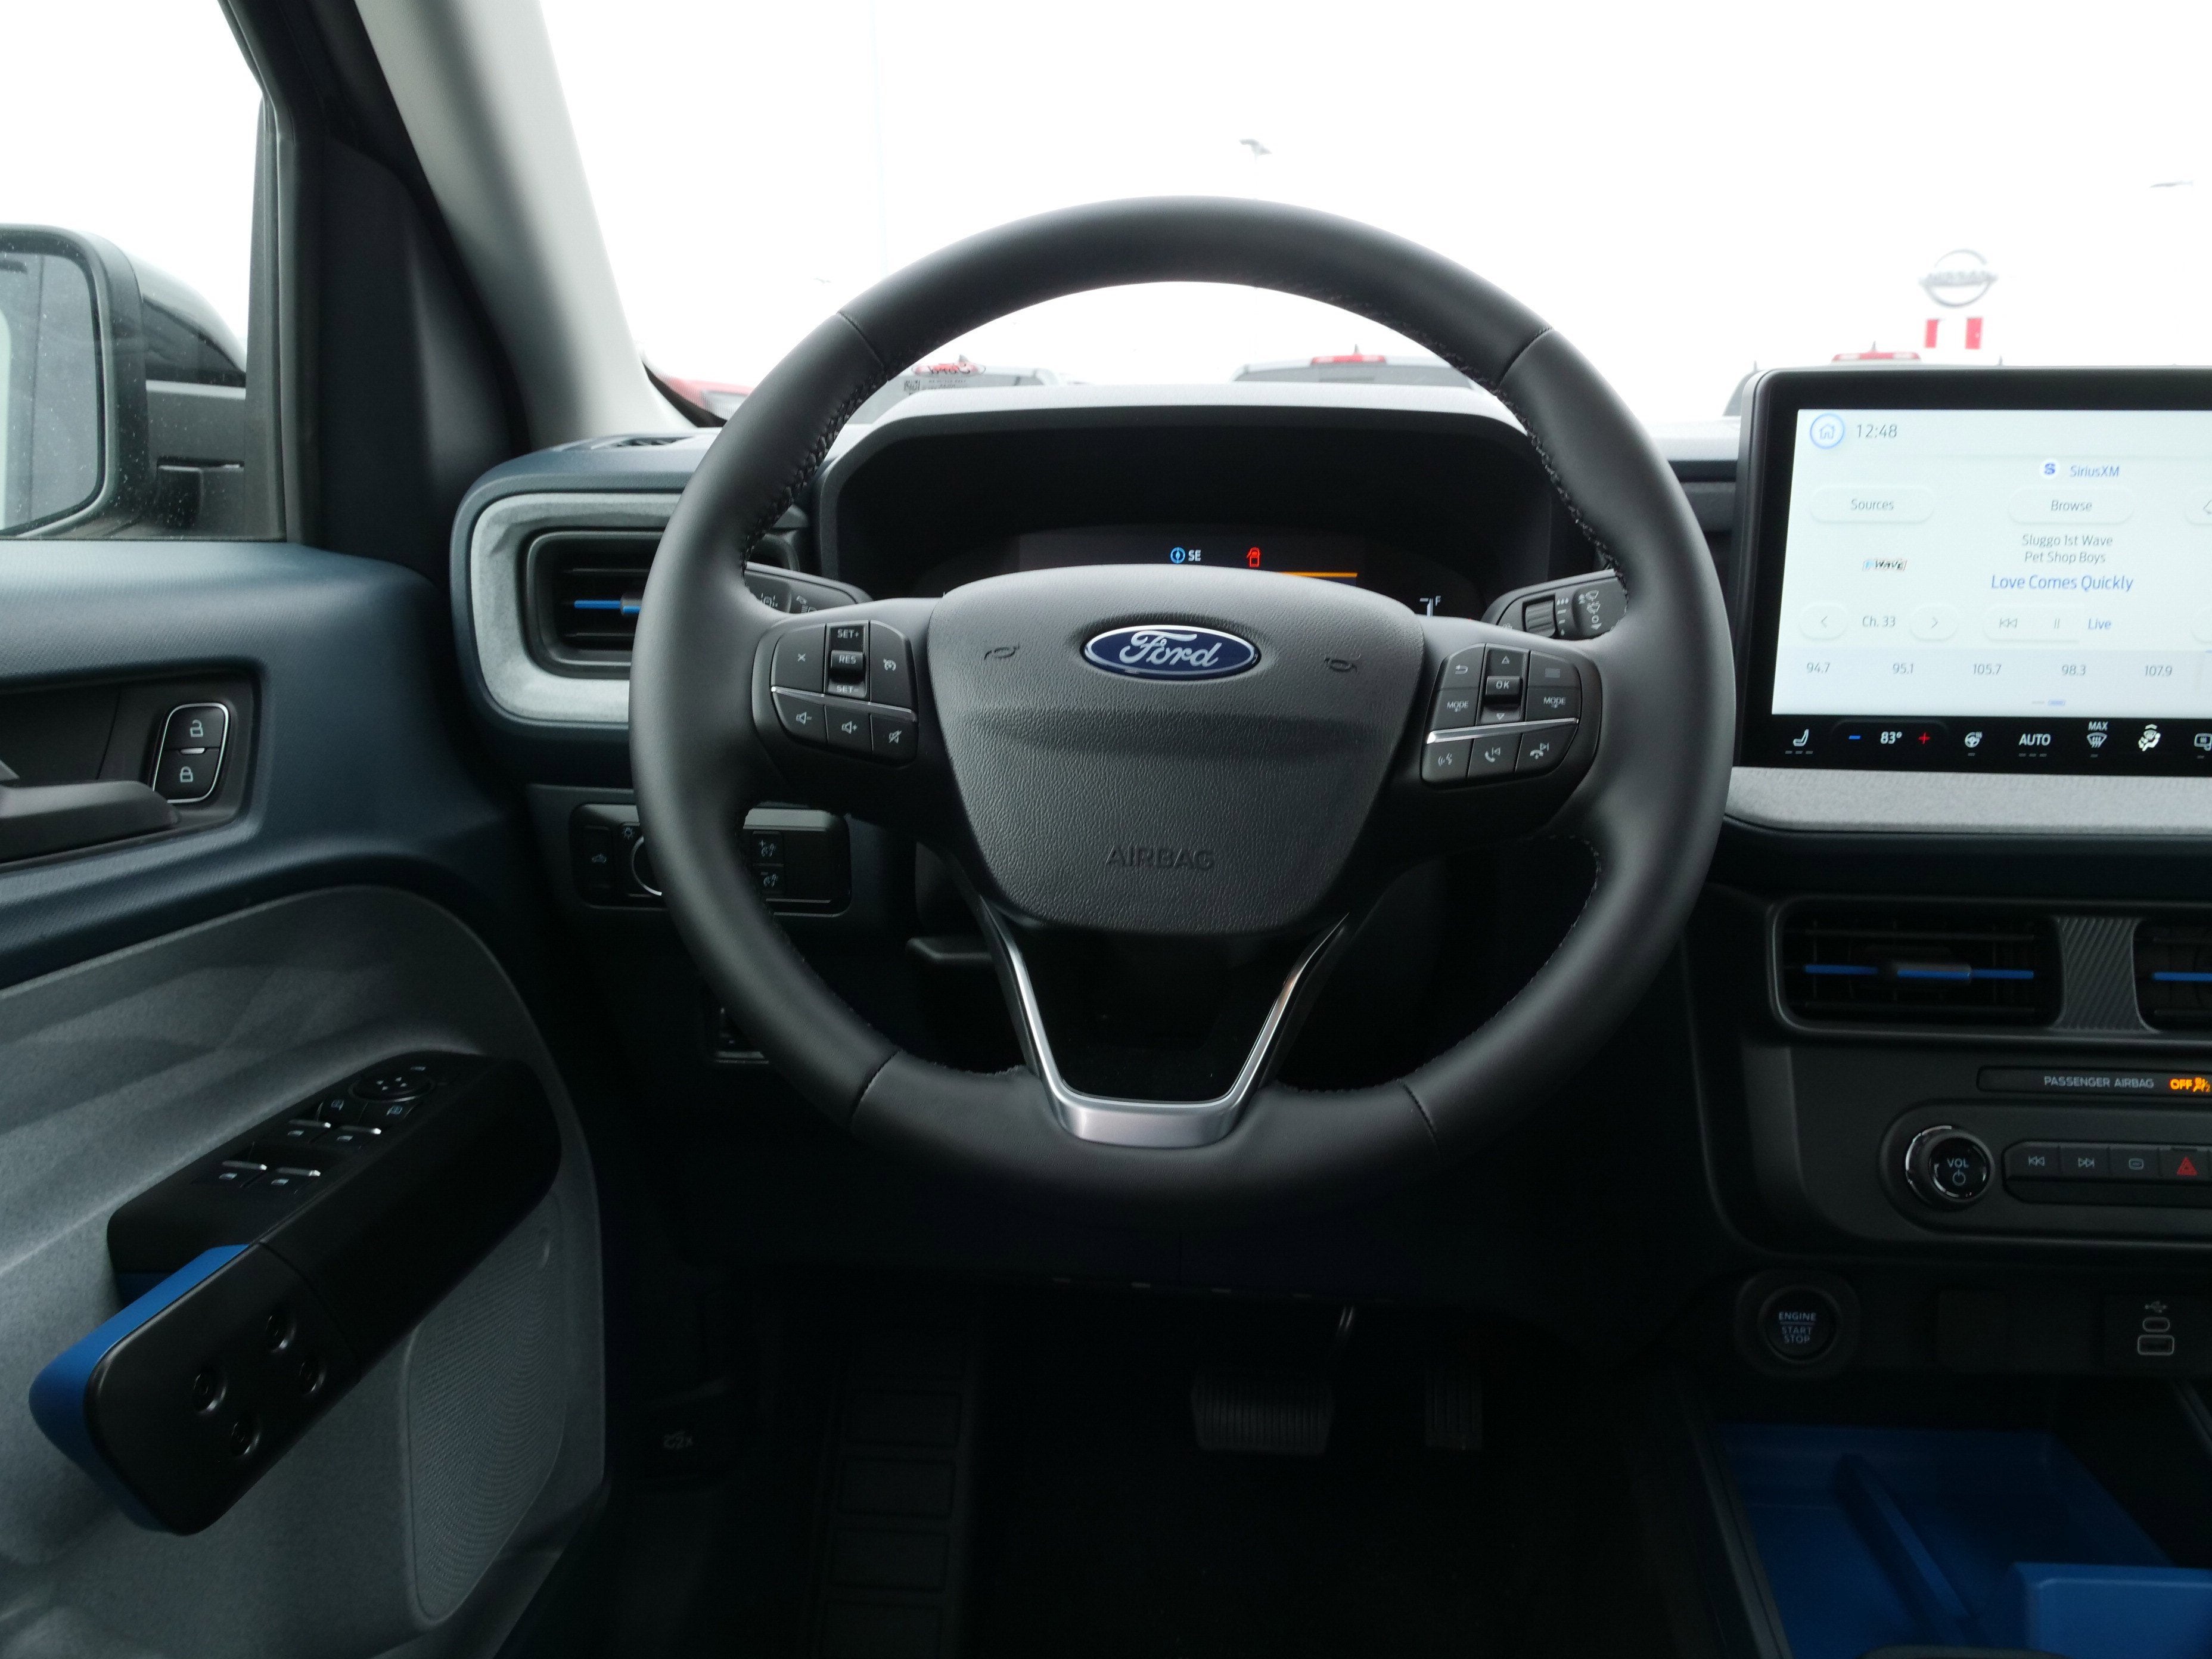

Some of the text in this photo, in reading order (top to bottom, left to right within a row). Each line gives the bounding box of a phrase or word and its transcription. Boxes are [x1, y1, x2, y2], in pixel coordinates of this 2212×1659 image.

[1857, 424, 1897, 439] 12:48
[2070, 465, 2120, 477] SiriusXM
[1851, 498, 1894, 511] Sources
[2051, 499, 2092, 512] Browse
[2023, 534, 2113, 548] Sluggo 1st Wave
[1188, 549, 1201, 561] SE
[2025, 551, 2106, 565] Pet Shop Boys
[1992, 574, 2133, 592] Love Comes Quickly
[1862, 615, 1896, 627] Ch. 33
[2088, 618, 2112, 630] Live
[1119, 630, 1222, 667] Ford
[838, 654, 857, 664] RES
[1806, 661, 1831, 673] 94.7
[1892, 662, 1914, 675] 95.1
[1973, 663, 2002, 675] 105.7
[2061, 664, 2086, 676] 98.3
[2145, 664, 2173, 677] 107.9
[1495, 680, 1510, 690] OK
[1446, 701, 1469, 710] MODE
[1543, 696, 1566, 706] MODE
[2088, 721, 2108, 731] MAX
[1880, 731, 1903, 744] 83°
[2018, 733, 2052, 746] AUTO
[1105, 845, 1214, 871] AIRBAG
[2044, 1076, 2154, 1089] PASSENGER AIRBAG
[2170, 1078, 2193, 1091] OFF
[1947, 1158, 1969, 1169] VOL
[1779, 1312, 1816, 1321] ENGINE
[1781, 1325, 1813, 1335] START
[1784, 1335, 1810, 1344] STOP
